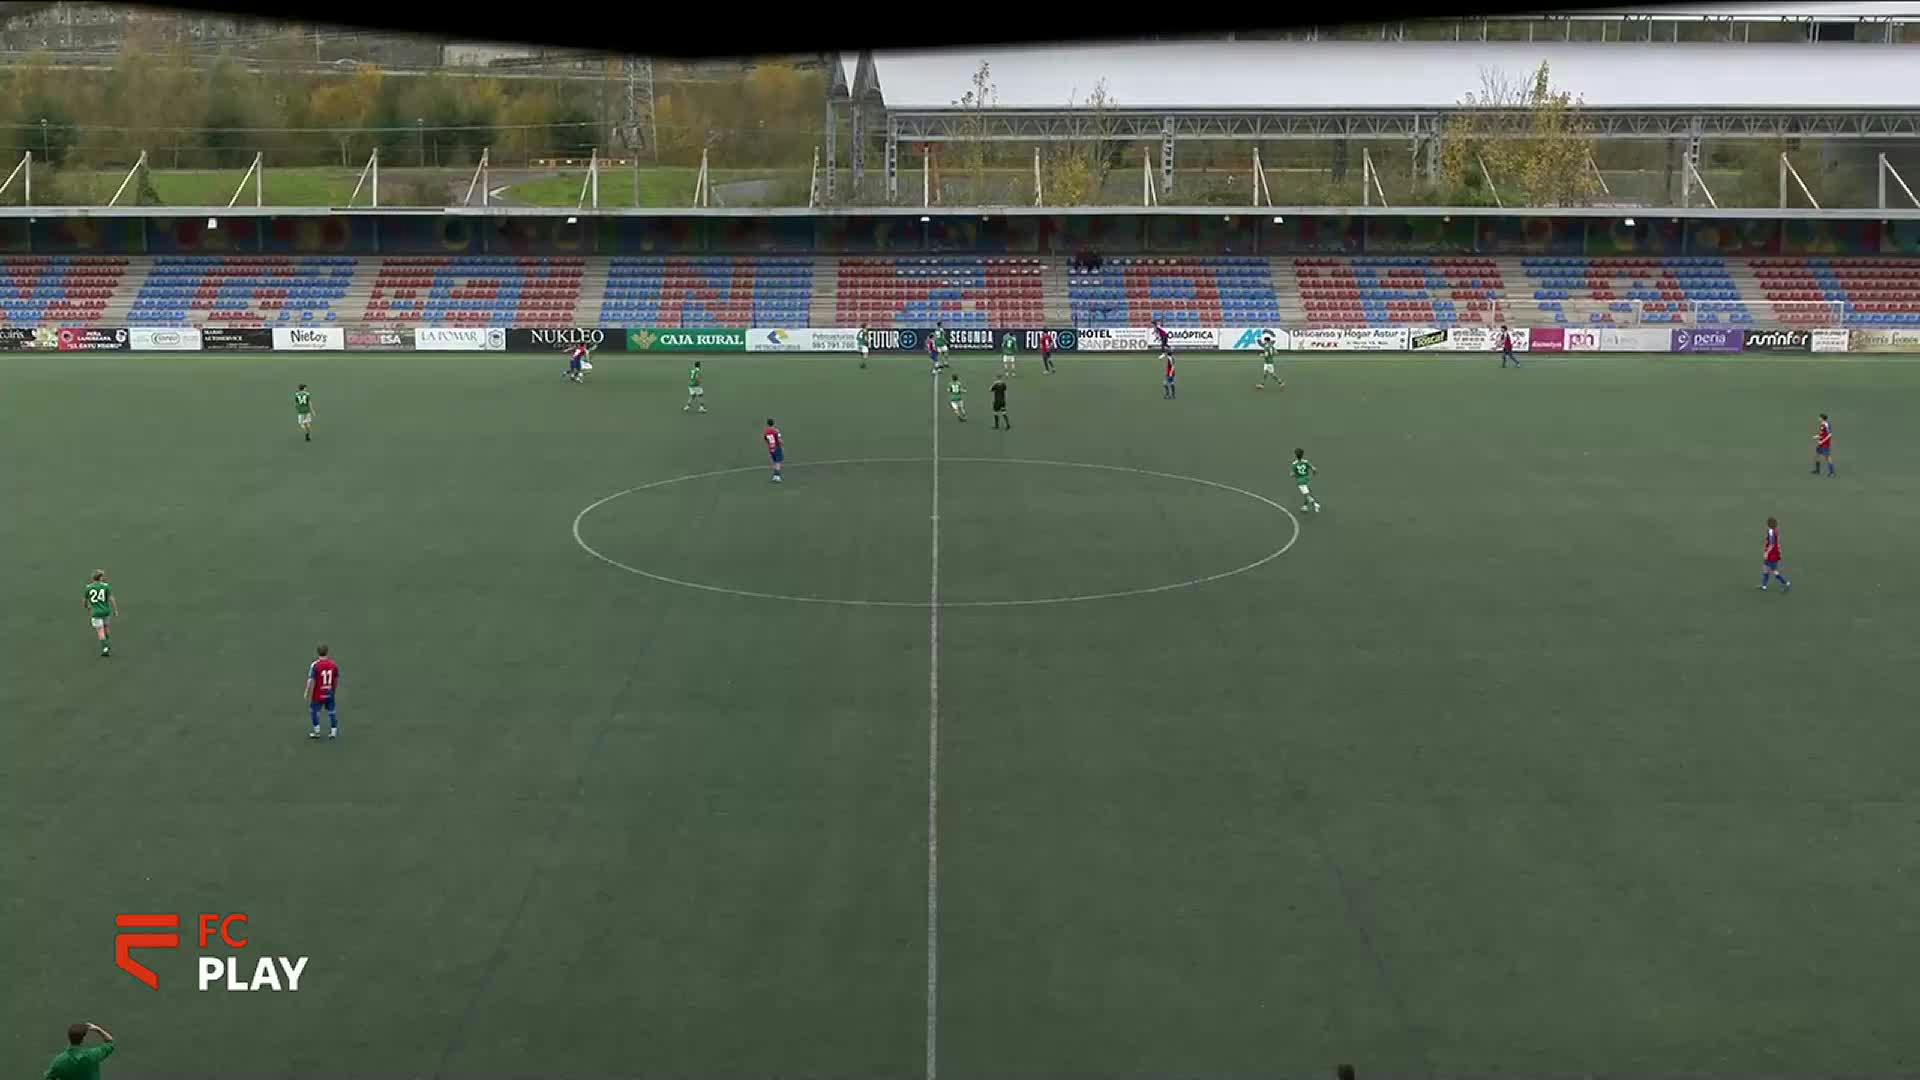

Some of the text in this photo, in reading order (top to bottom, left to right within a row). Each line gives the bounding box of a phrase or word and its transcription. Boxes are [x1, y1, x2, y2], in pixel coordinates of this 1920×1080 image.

[290, 329, 328, 344] Nieto's
[660, 335, 744, 344] CAJA RURAL
[1079, 330, 1112, 338] HOTEL
[89, 588, 105, 602] 24
[321, 669, 333, 685] 11
